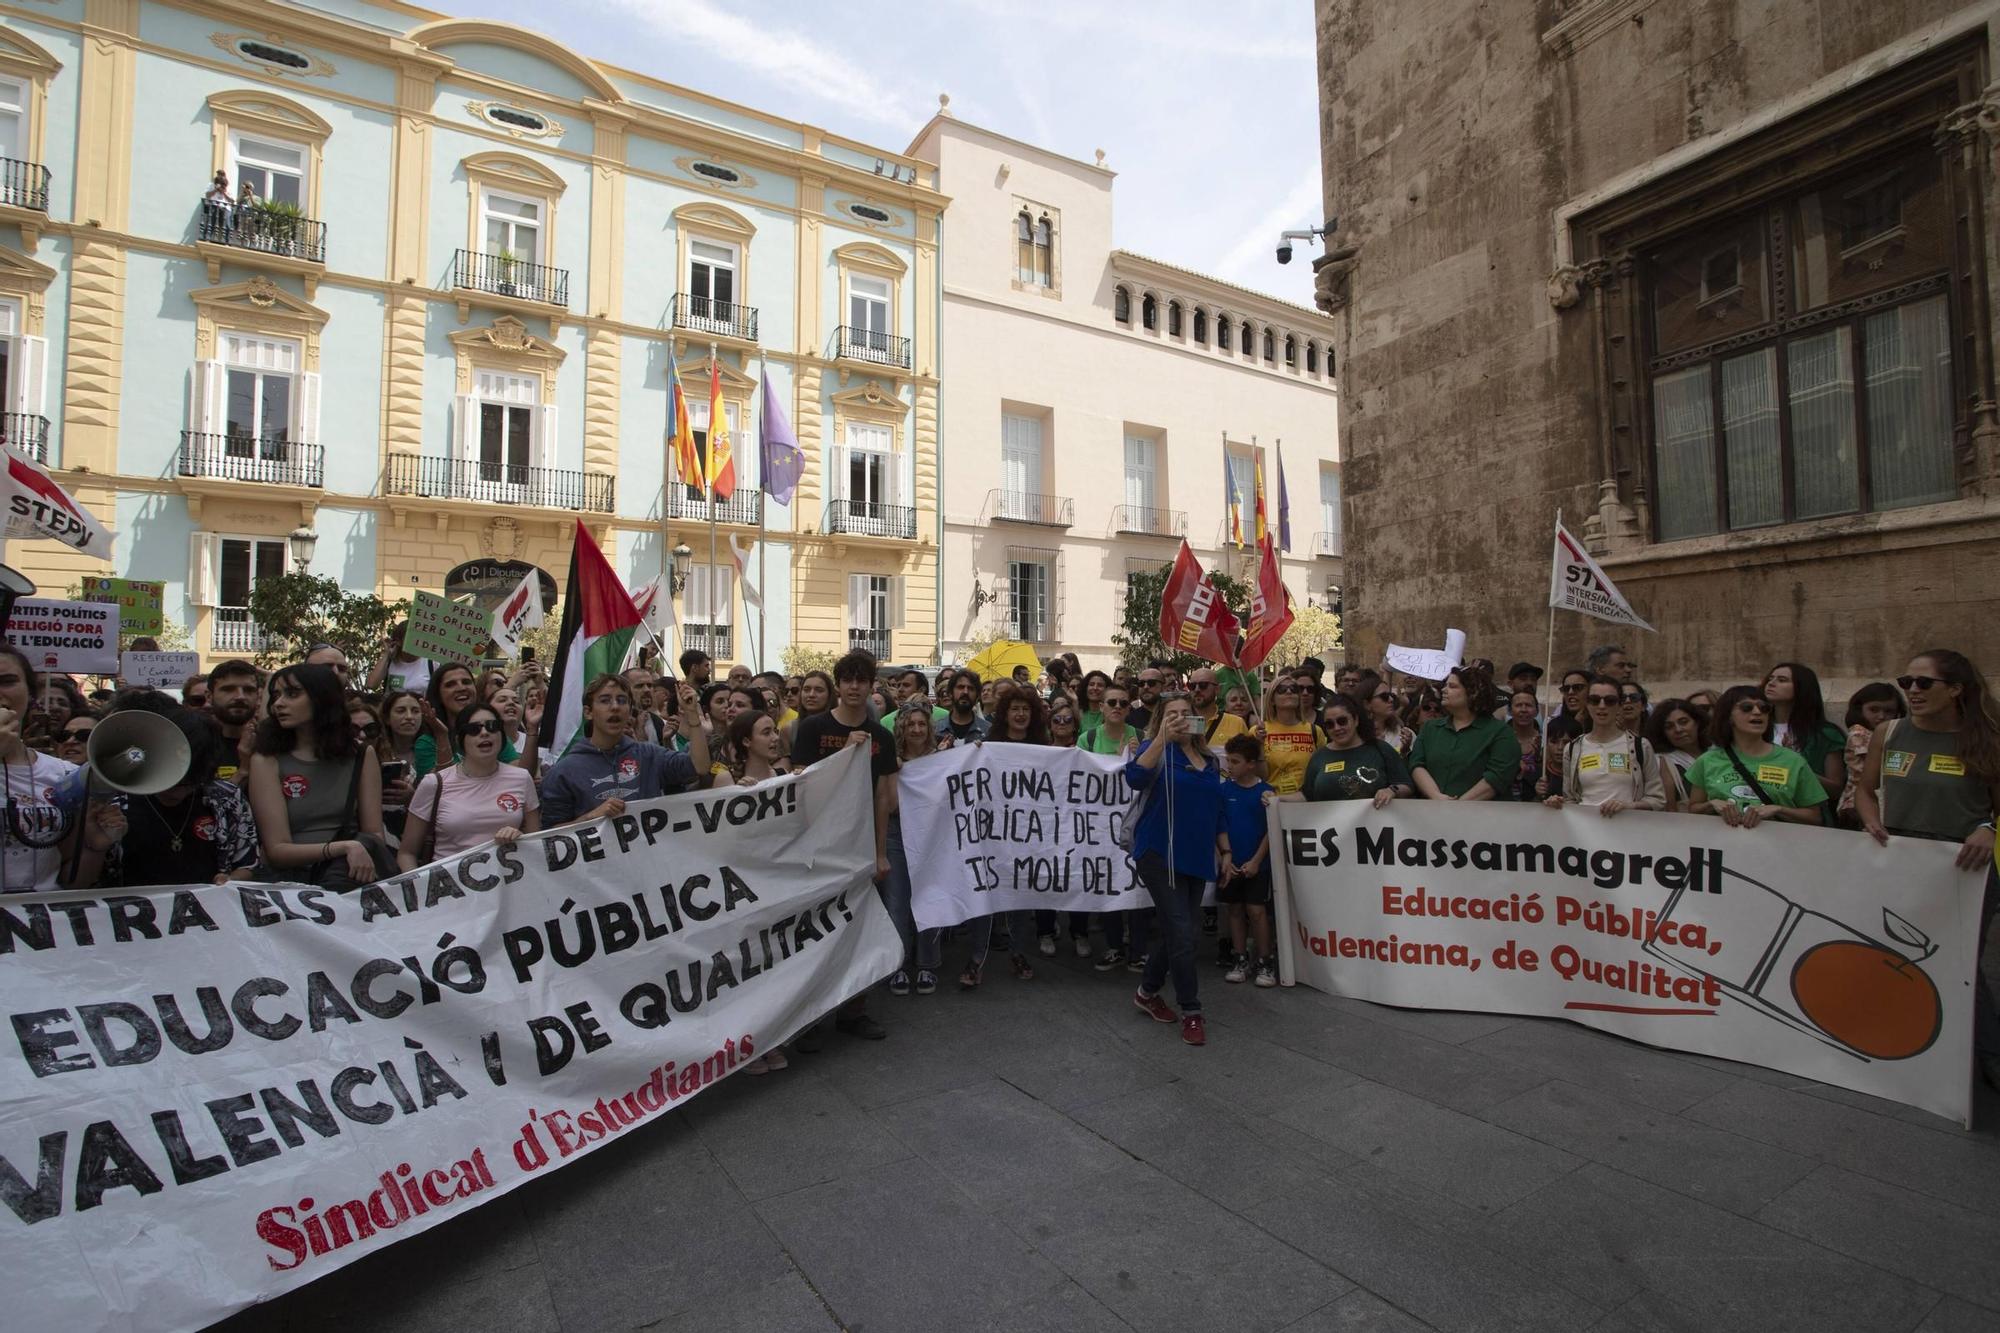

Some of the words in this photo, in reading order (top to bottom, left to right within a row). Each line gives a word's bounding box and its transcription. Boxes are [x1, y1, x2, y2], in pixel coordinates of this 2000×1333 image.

[9, 495, 93, 547] STEPV
[6, 619, 62, 632] RELIGIÓ
[67, 622, 103, 635] FORA
[53, 606, 107, 620] POLÍTICS
[415, 608, 437, 621] ELS
[443, 615, 491, 641] ORIGENS
[417, 594, 440, 609] QUI
[452, 605, 484, 621] PERD
[22, 634, 105, 650] L'EDUCACIÓ
[414, 621, 447, 637] PERD
[457, 634, 472, 645] LA
[415, 639, 481, 669] IDENTITAT
[947, 767, 993, 810] PER
[1001, 768, 1056, 802] UNA
[1074, 811, 1100, 846] DE
[238, 885, 336, 928] ELS
[360, 843, 525, 923] ATACS
[543, 826, 606, 872] DE
[611, 782, 798, 854] PP-VOX!
[1013, 848, 1076, 893] MOLÍ
[1082, 856, 1121, 896] DEL
[1355, 825, 1723, 895] Massamagrell
[1382, 885, 1545, 924] Educació
[1556, 895, 1723, 956] Pública,
[10, 932, 487, 1078] EDUCACIÓ
[504, 865, 758, 984] PÚBLICA
[1492, 940, 1539, 972] de
[1551, 945, 1722, 1007] Qualitat
[0, 1036, 468, 1226] VALENCIÀ
[480, 1031, 506, 1086] I
[526, 1001, 613, 1077] DE
[620, 890, 854, 1030] QUALITAT!
[256, 1147, 498, 1272] Sindicat
[513, 1033, 755, 1172] d'Estudiants
